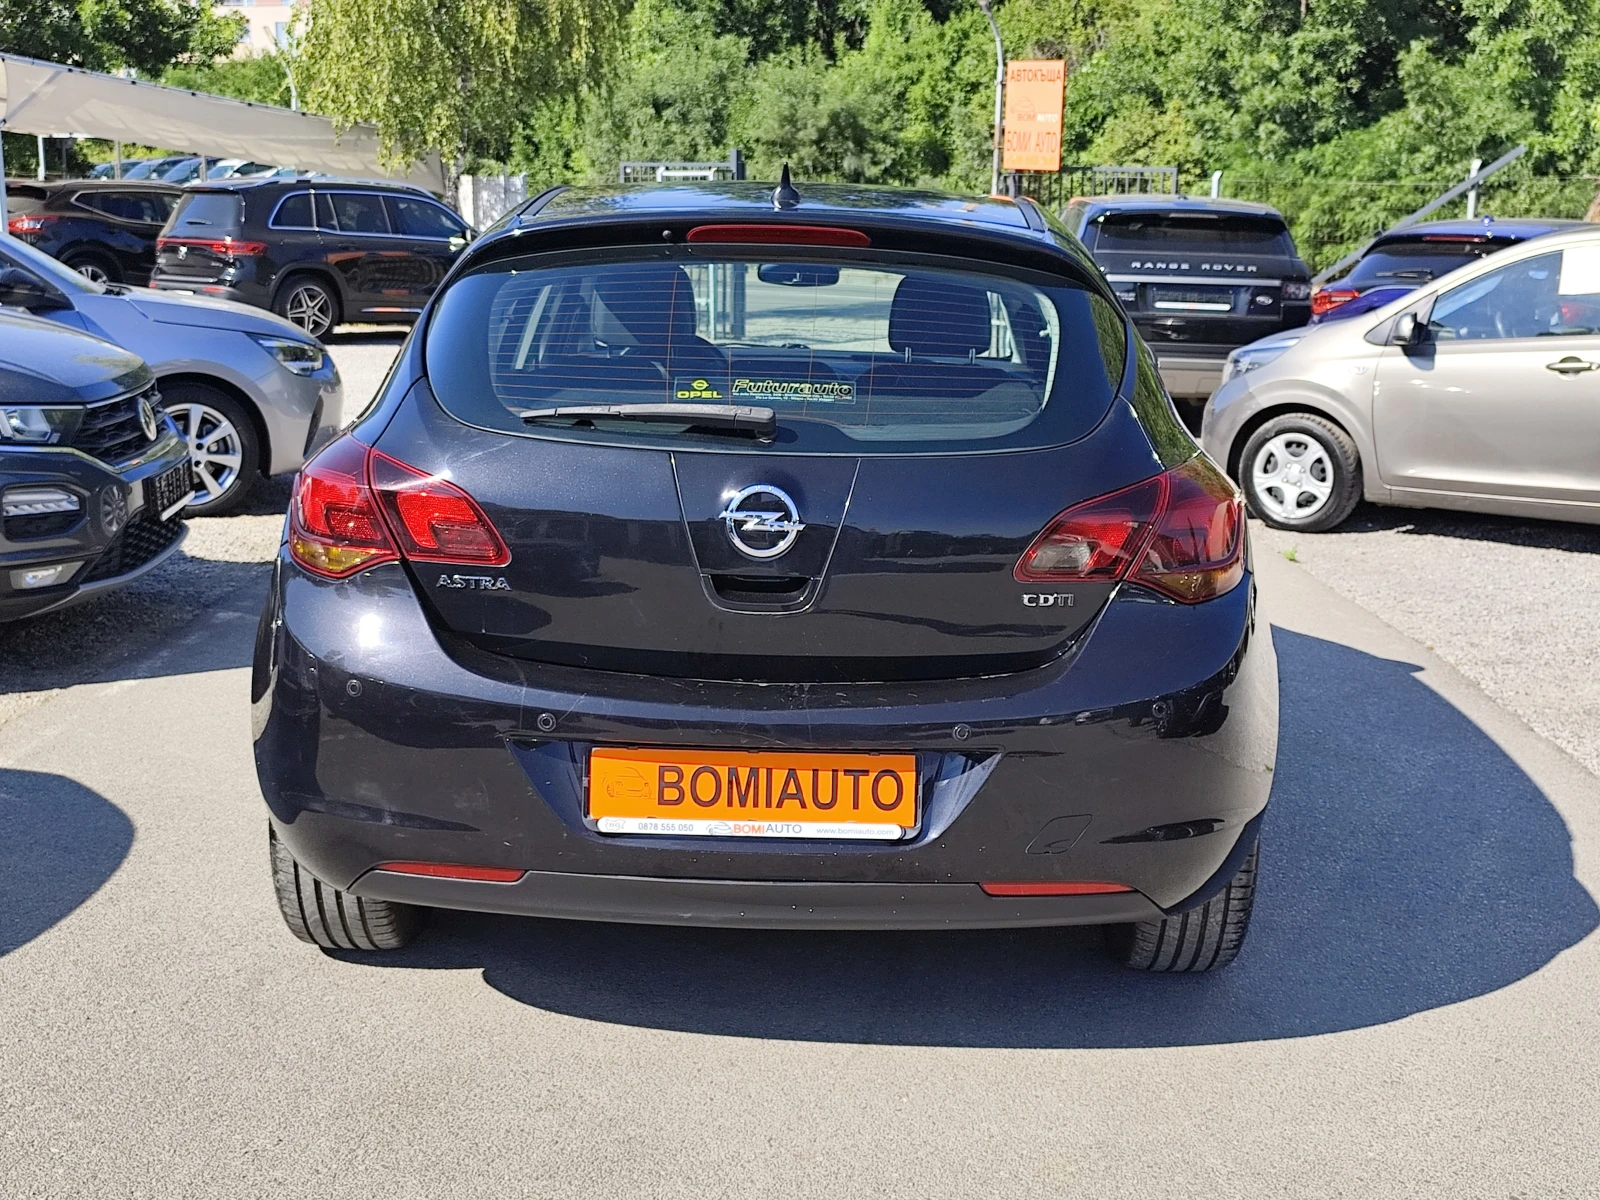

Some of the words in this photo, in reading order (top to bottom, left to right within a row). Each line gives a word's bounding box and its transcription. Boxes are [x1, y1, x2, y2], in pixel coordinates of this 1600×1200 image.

[1011, 69, 1061, 83] АВТОКЪЩА
[1131, 261, 1190, 270] RANGE
[1201, 263, 1258, 272] ROVER
[732, 378, 853, 395] Futurauto
[676, 390, 723, 399] OPEL
[436, 574, 512, 591] ASTRA
[1022, 593, 1074, 607] CDTI
[657, 764, 904, 811] BOMIAUTO
[637, 822, 658, 831] 0878
[660, 823, 676, 831] 555
[678, 823, 694, 832] 050
[733, 823, 803, 834] BOMIAUTO
[816, 827, 894, 836] www.bomiauto.com
